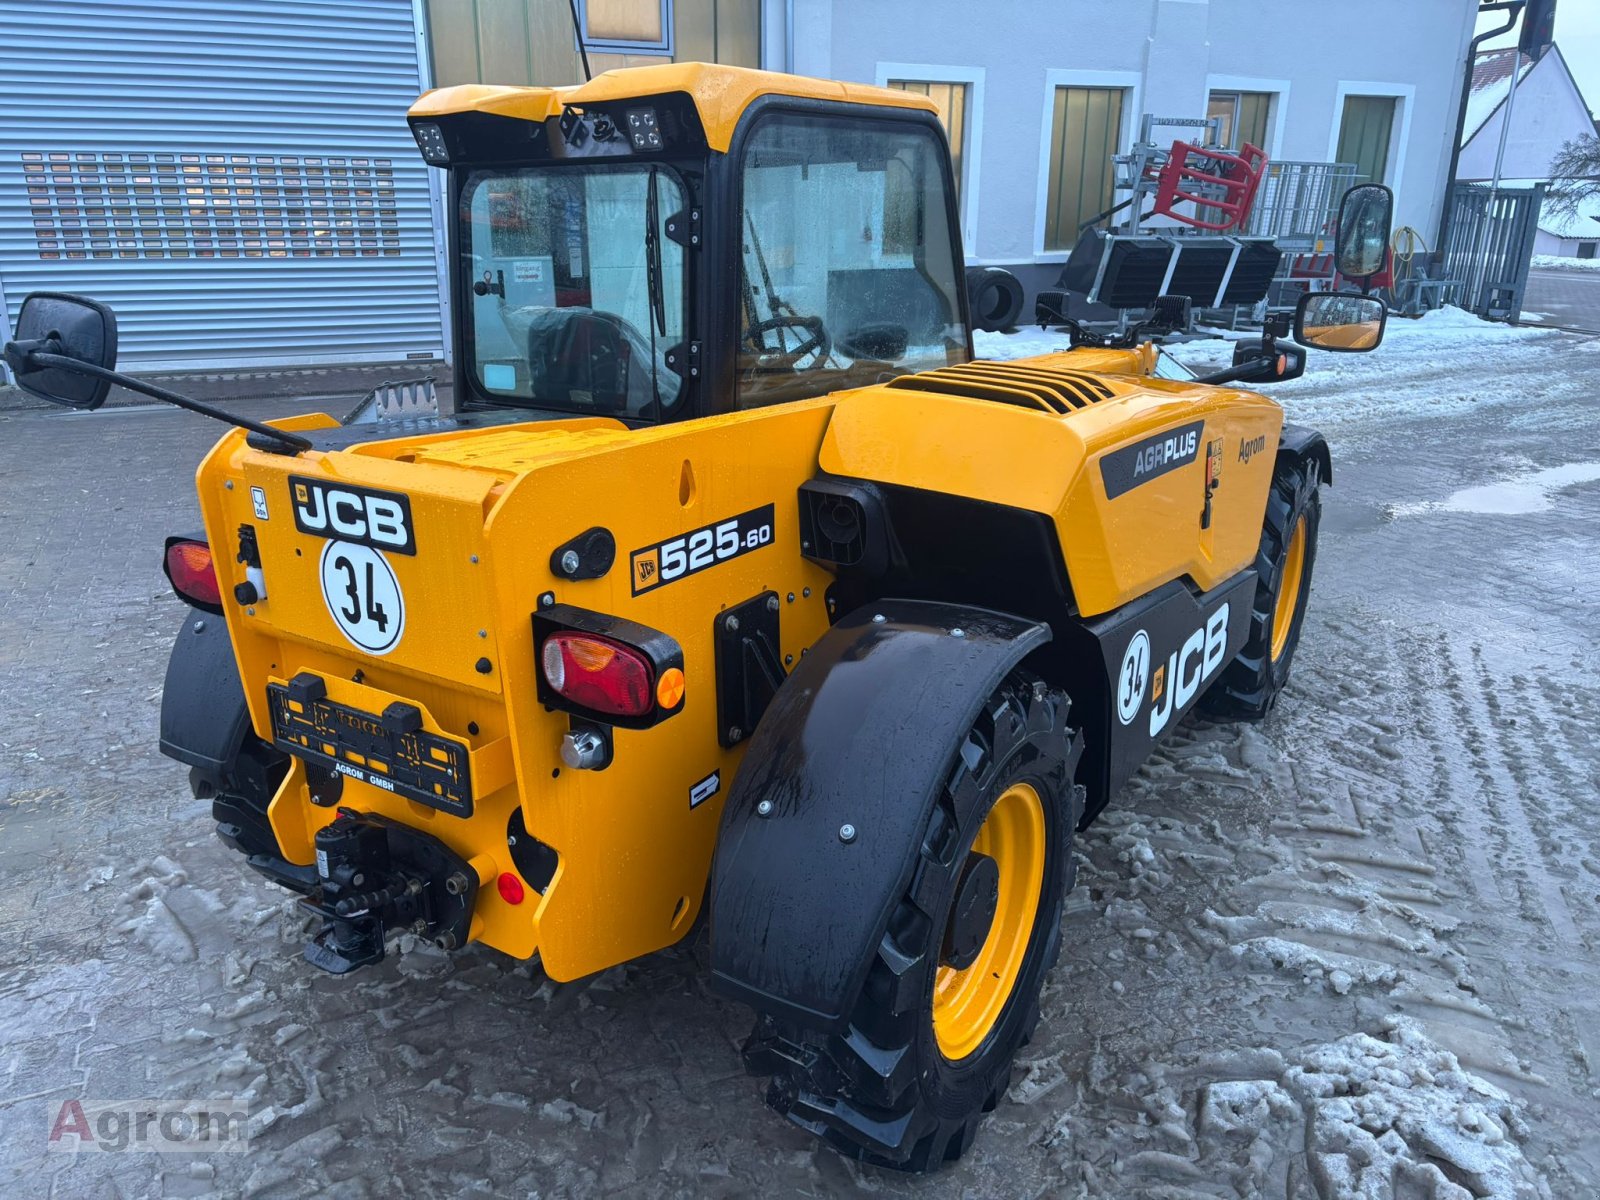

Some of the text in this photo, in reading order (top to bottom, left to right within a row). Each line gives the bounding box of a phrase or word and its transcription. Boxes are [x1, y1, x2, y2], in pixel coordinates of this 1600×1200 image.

[1238, 434, 1265, 465] Agrom
[298, 486, 408, 547] JCB
[335, 555, 389, 634] 34
[640, 561, 655, 579] JCB
[1124, 647, 1143, 708] 34
[1149, 602, 1230, 737] JCB
[335, 763, 394, 791] AGROM GMBH
